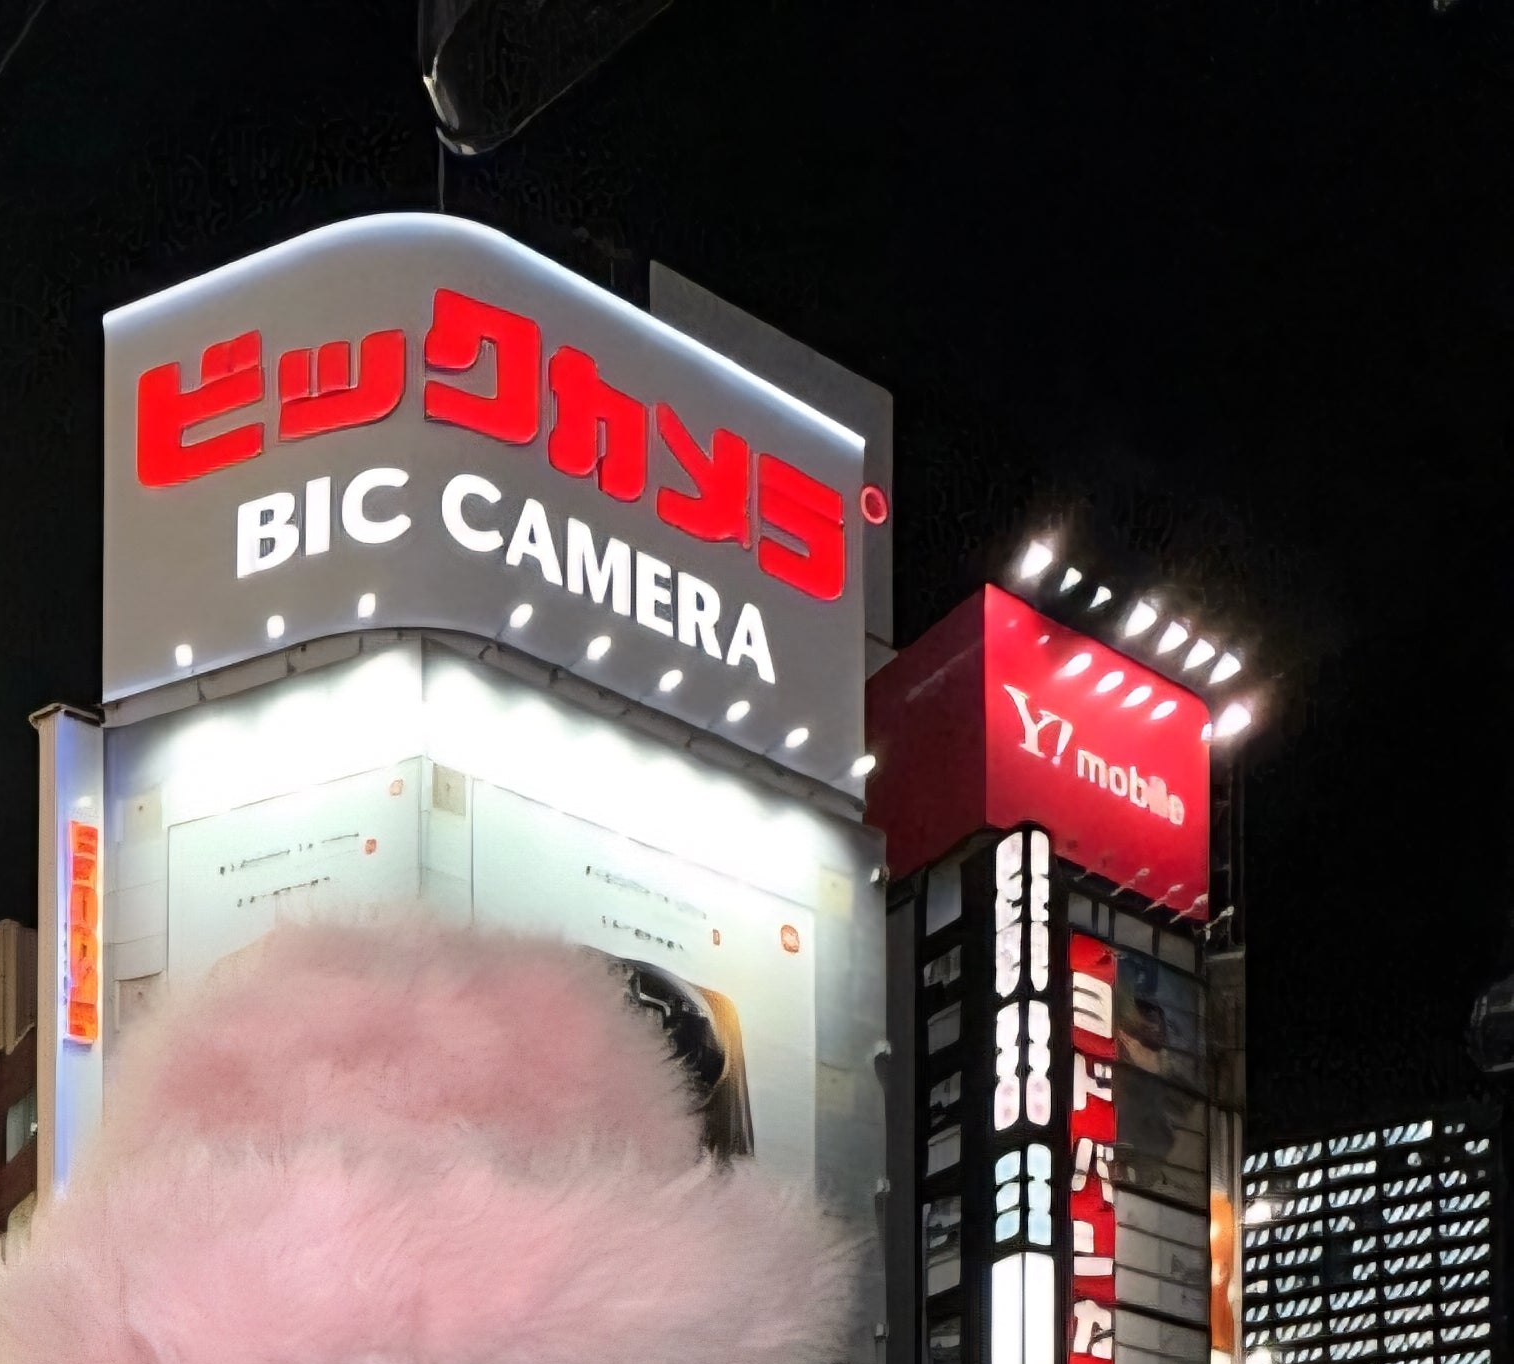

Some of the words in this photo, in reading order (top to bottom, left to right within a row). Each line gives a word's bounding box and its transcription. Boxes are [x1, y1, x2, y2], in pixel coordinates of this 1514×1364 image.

[136, 287, 846, 602] ビックカメラ
[235, 467, 412, 579] BIC
[440, 472, 776, 684] CAMERA
